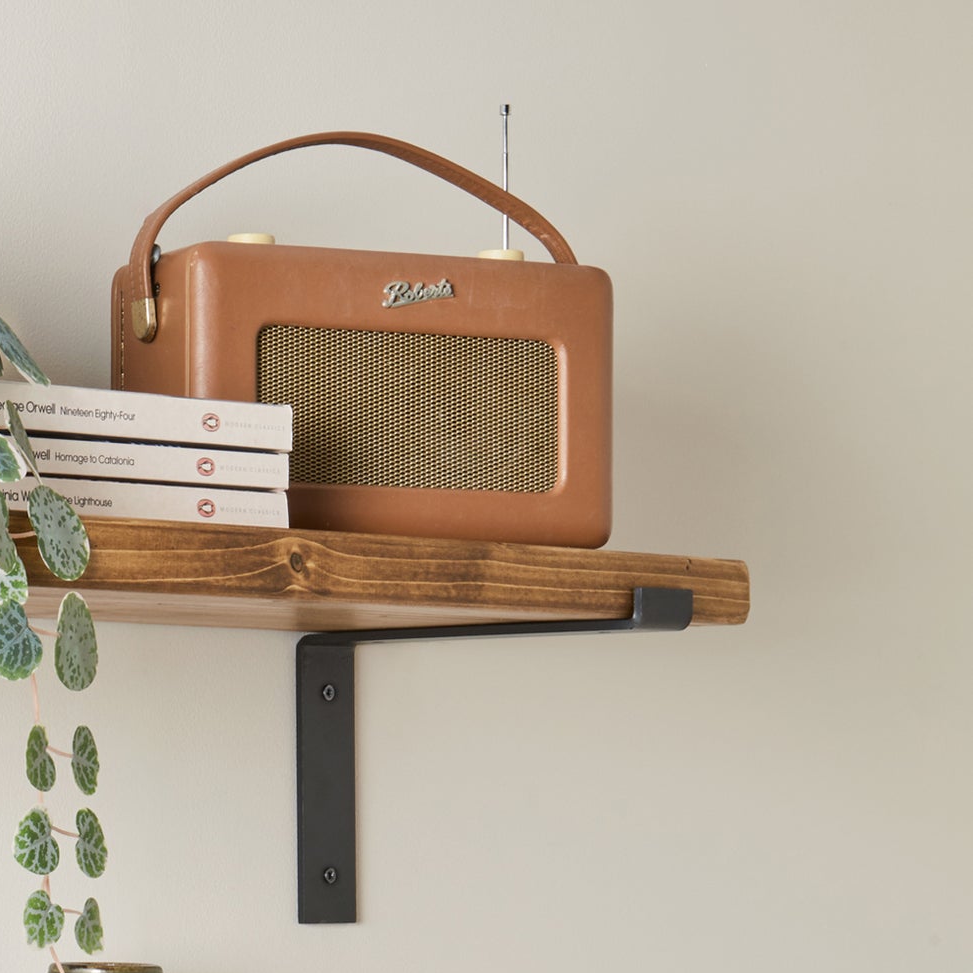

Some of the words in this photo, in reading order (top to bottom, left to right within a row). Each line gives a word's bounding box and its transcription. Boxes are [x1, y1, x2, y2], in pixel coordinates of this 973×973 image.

[382, 278, 454, 308] Roberts
[26, 401, 56, 415] Orwell
[60, 406, 94, 417] Nineteen
[94, 408, 136, 421] Eighty-Four
[32, 449, 51, 461] well
[54, 452, 88, 465] Homage
[89, 455, 97, 464] to
[98, 454, 135, 466] Catalonia
[73, 495, 113, 508] Lighthouse
